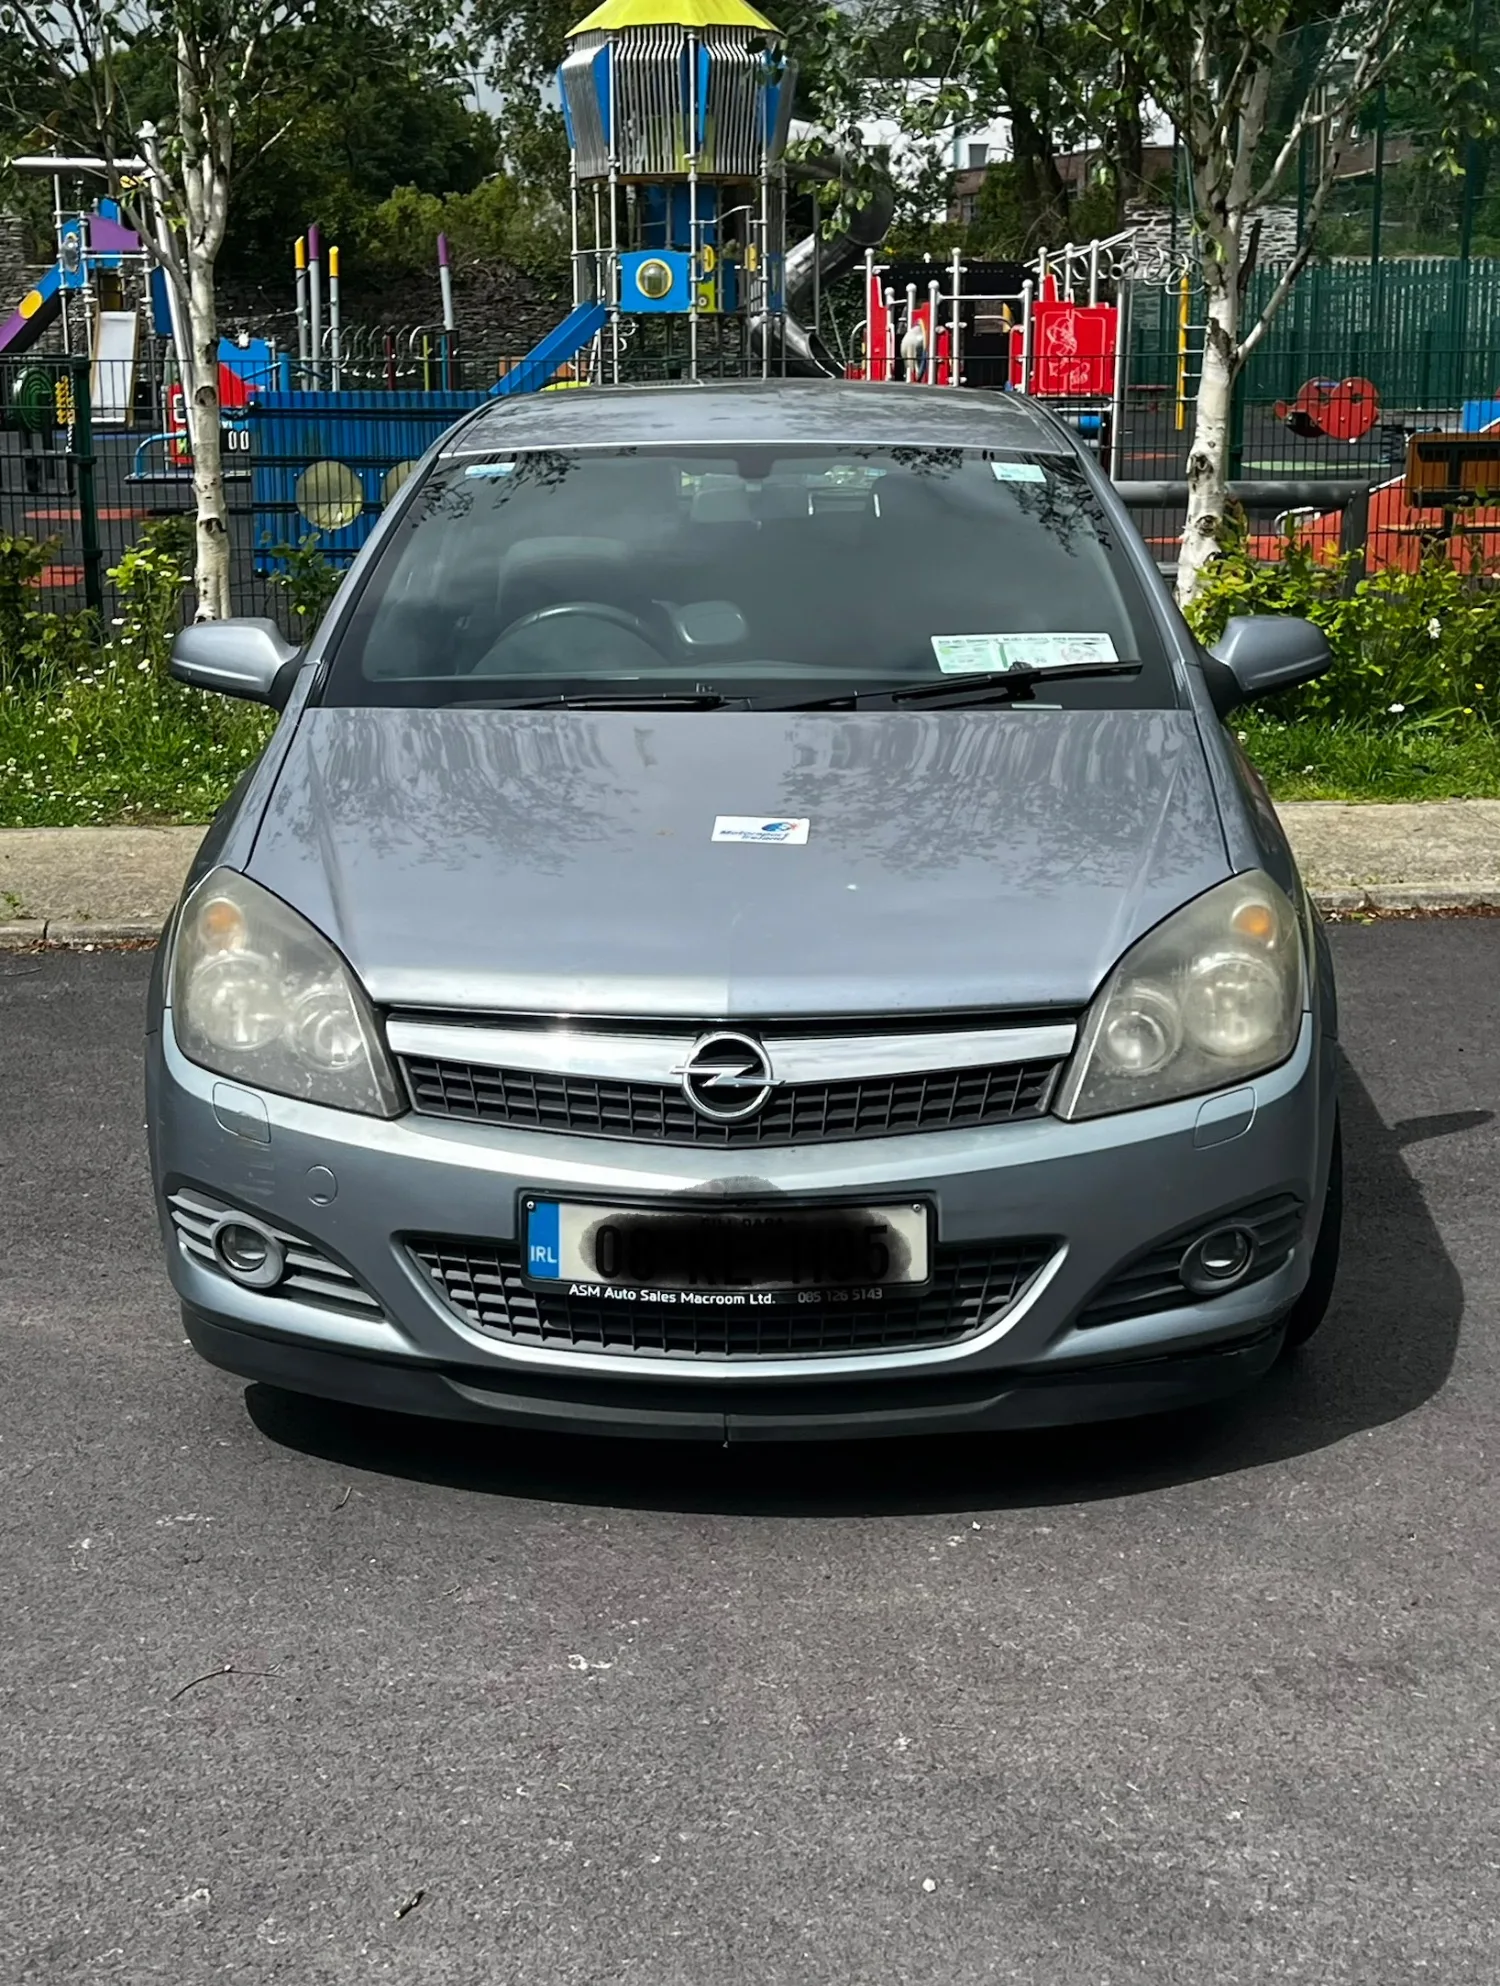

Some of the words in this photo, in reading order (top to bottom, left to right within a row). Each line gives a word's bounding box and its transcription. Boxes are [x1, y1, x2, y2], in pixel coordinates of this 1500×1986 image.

[530, 1245, 557, 1264] IRL
[569, 1284, 600, 1297] ASM
[604, 1287, 637, 1300] Auto
[640, 1290, 676, 1303] Sales
[681, 1292, 745, 1305] Macroom
[750, 1294, 776, 1305] Ltd.
